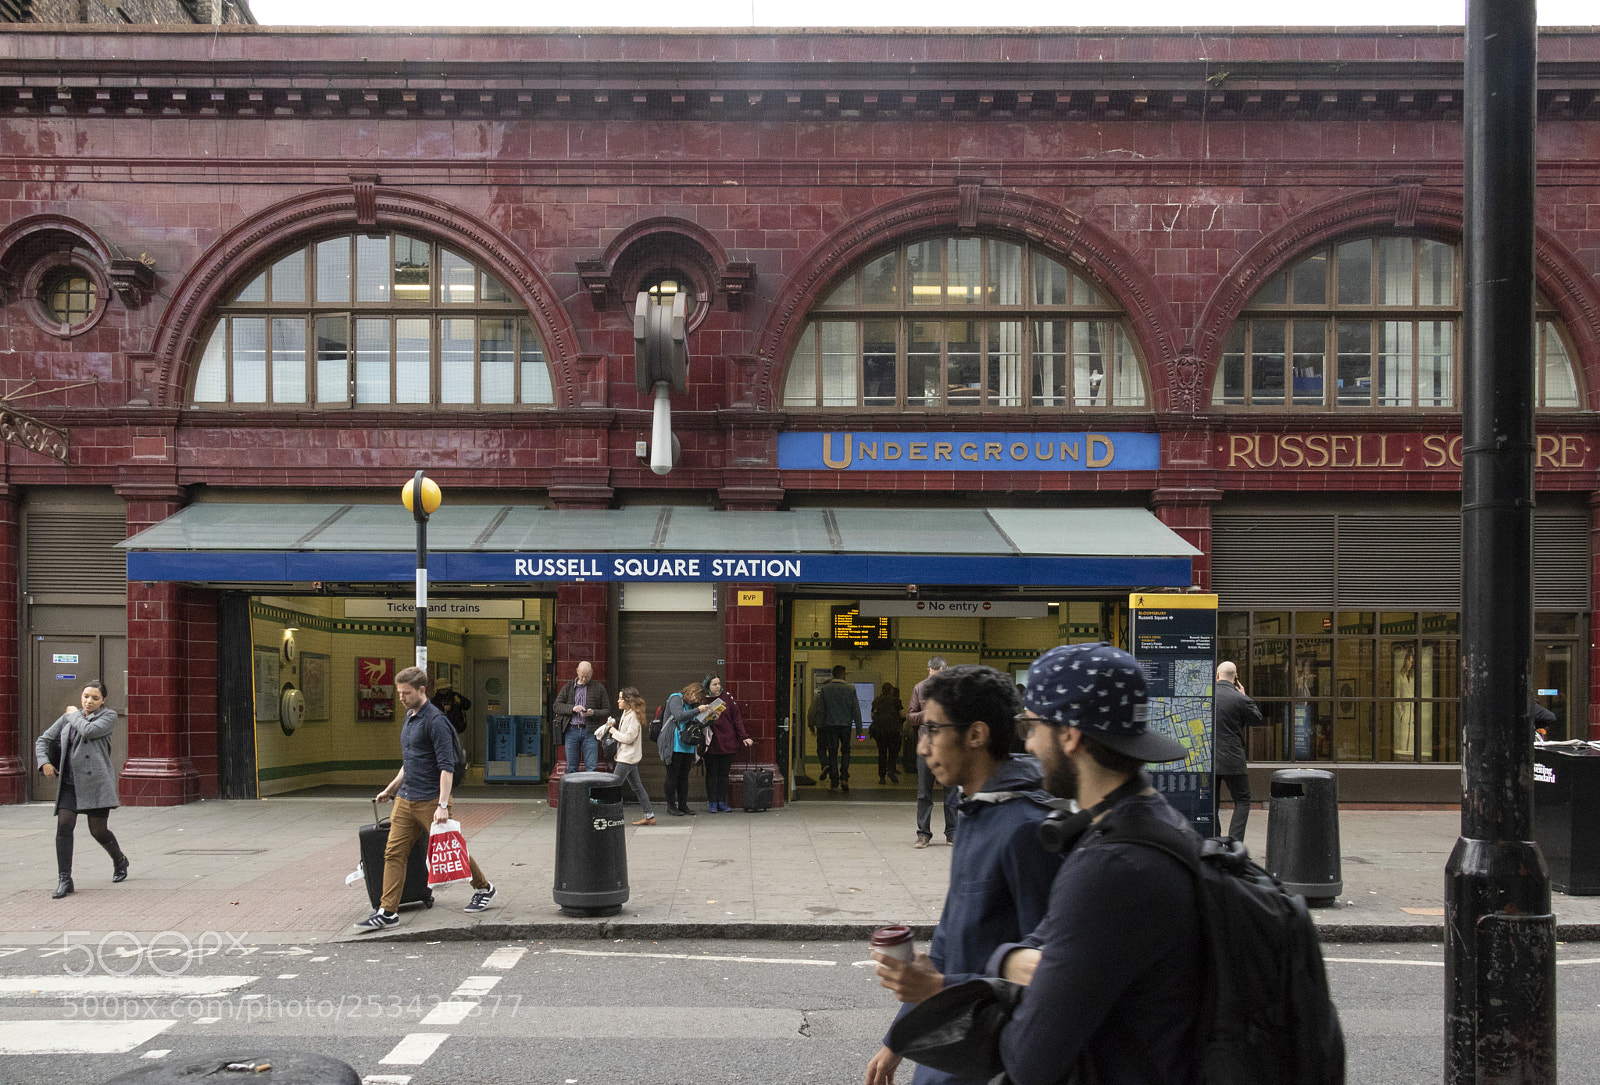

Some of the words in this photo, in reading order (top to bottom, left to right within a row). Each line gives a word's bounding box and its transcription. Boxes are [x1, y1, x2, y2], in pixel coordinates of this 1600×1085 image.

[1228, 434, 1405, 468] RUSSELL
[515, 558, 603, 577] RUSSELL
[613, 558, 701, 578] SQUARE
[711, 558, 801, 577] STATION
[387, 602, 417, 612] Ticke
[428, 602, 447, 612] and
[451, 602, 480, 612] trains
[928, 601, 946, 611] No
[948, 602, 979, 613] entry
[432, 841, 450, 852] TAX
[452, 839, 460, 848] &
[432, 850, 461, 863] DUTY
[433, 860, 462, 874] FREE
